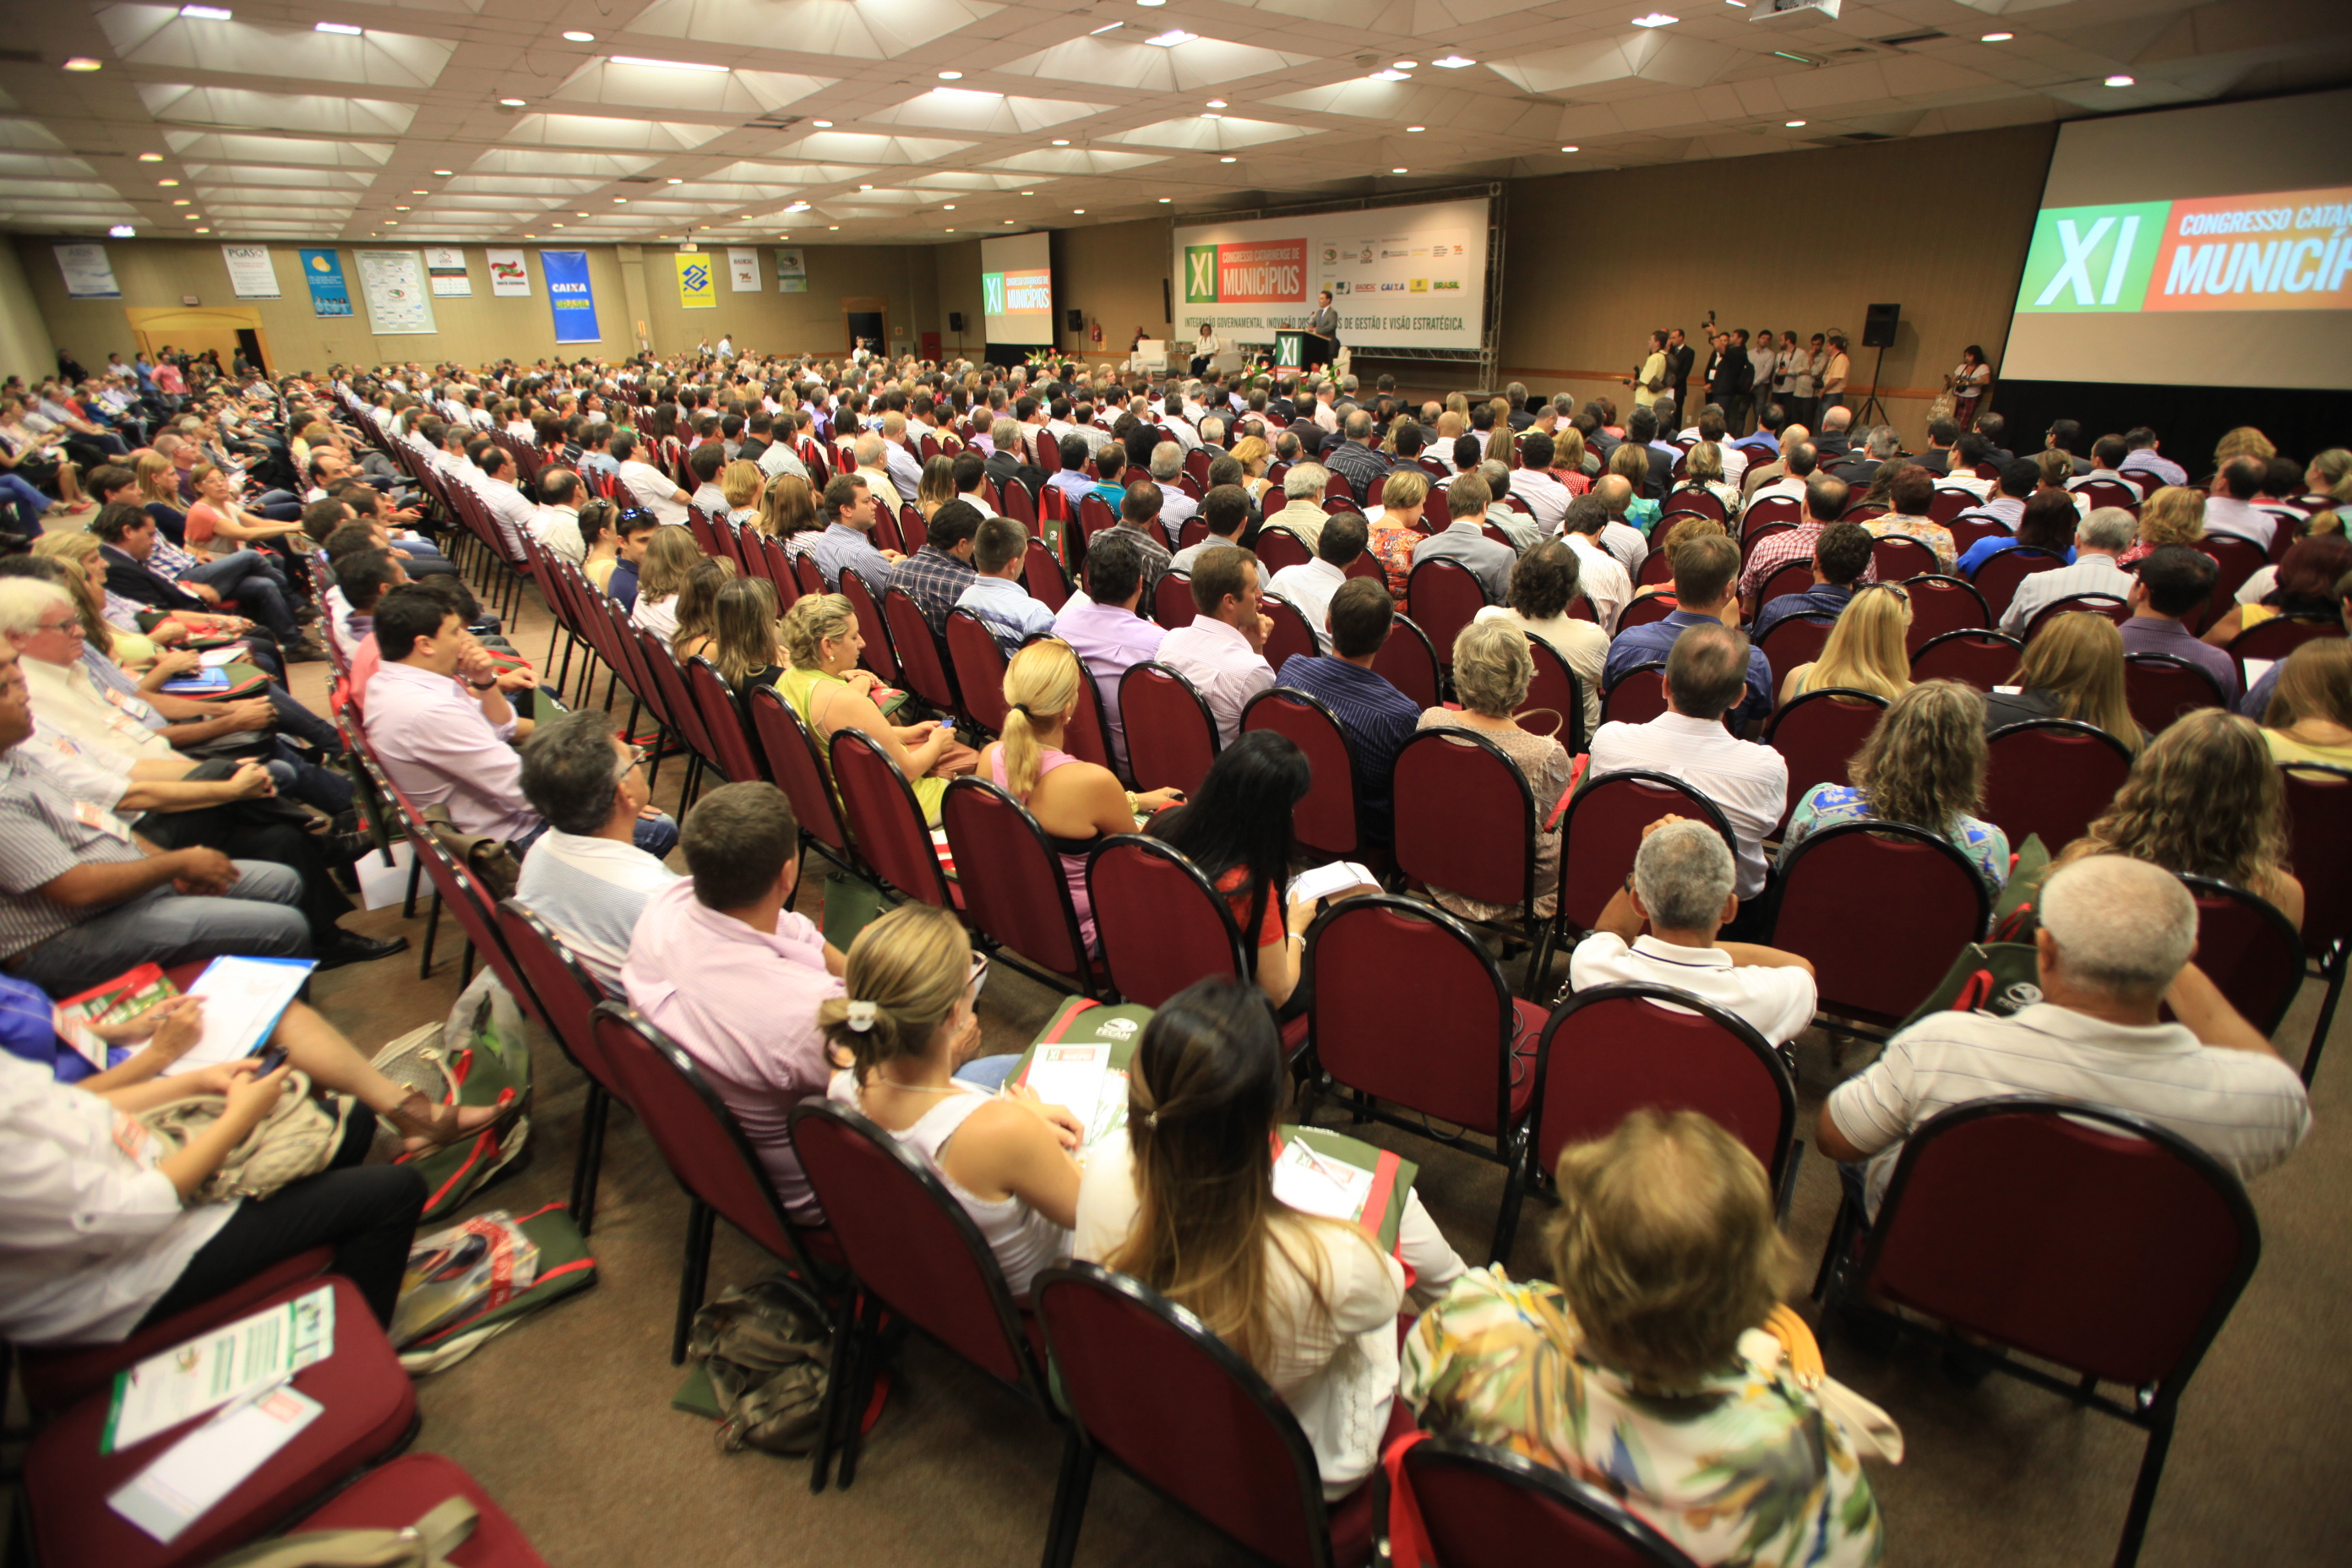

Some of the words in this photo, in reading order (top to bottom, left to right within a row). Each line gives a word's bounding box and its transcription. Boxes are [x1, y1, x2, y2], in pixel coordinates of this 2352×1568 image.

[2179, 208, 2293, 237] CONGRESSO
[1222, 252, 1254, 264] CONGRESSO
[1255, 249, 1291, 261] CATARINENSE
[1292, 248, 1300, 259] DE
[2034, 215, 2141, 306] XI
[1190, 253, 1213, 297] XI
[1223, 262, 1299, 296] MUNICÍPIOS
[552, 283, 588, 292] CAIXA
[986, 277, 1002, 313] XI
[1381, 283, 1405, 291] CAIXA
[1434, 281, 1460, 290] BRASIL
[1007, 285, 1050, 310] MUNICÍPIOS
[1217, 318, 1266, 329] GOVERNAMENTAL,
[1345, 318, 1353, 329] DE
[1355, 316, 1380, 330] GESTÃO
[1383, 318, 1388, 329] E
[1389, 315, 1411, 330] VISÃO
[1413, 315, 1466, 331] ESTRATÉGICA.
[1280, 338, 1298, 366] XI
[1096, 1026, 1131, 1042] FECAM
